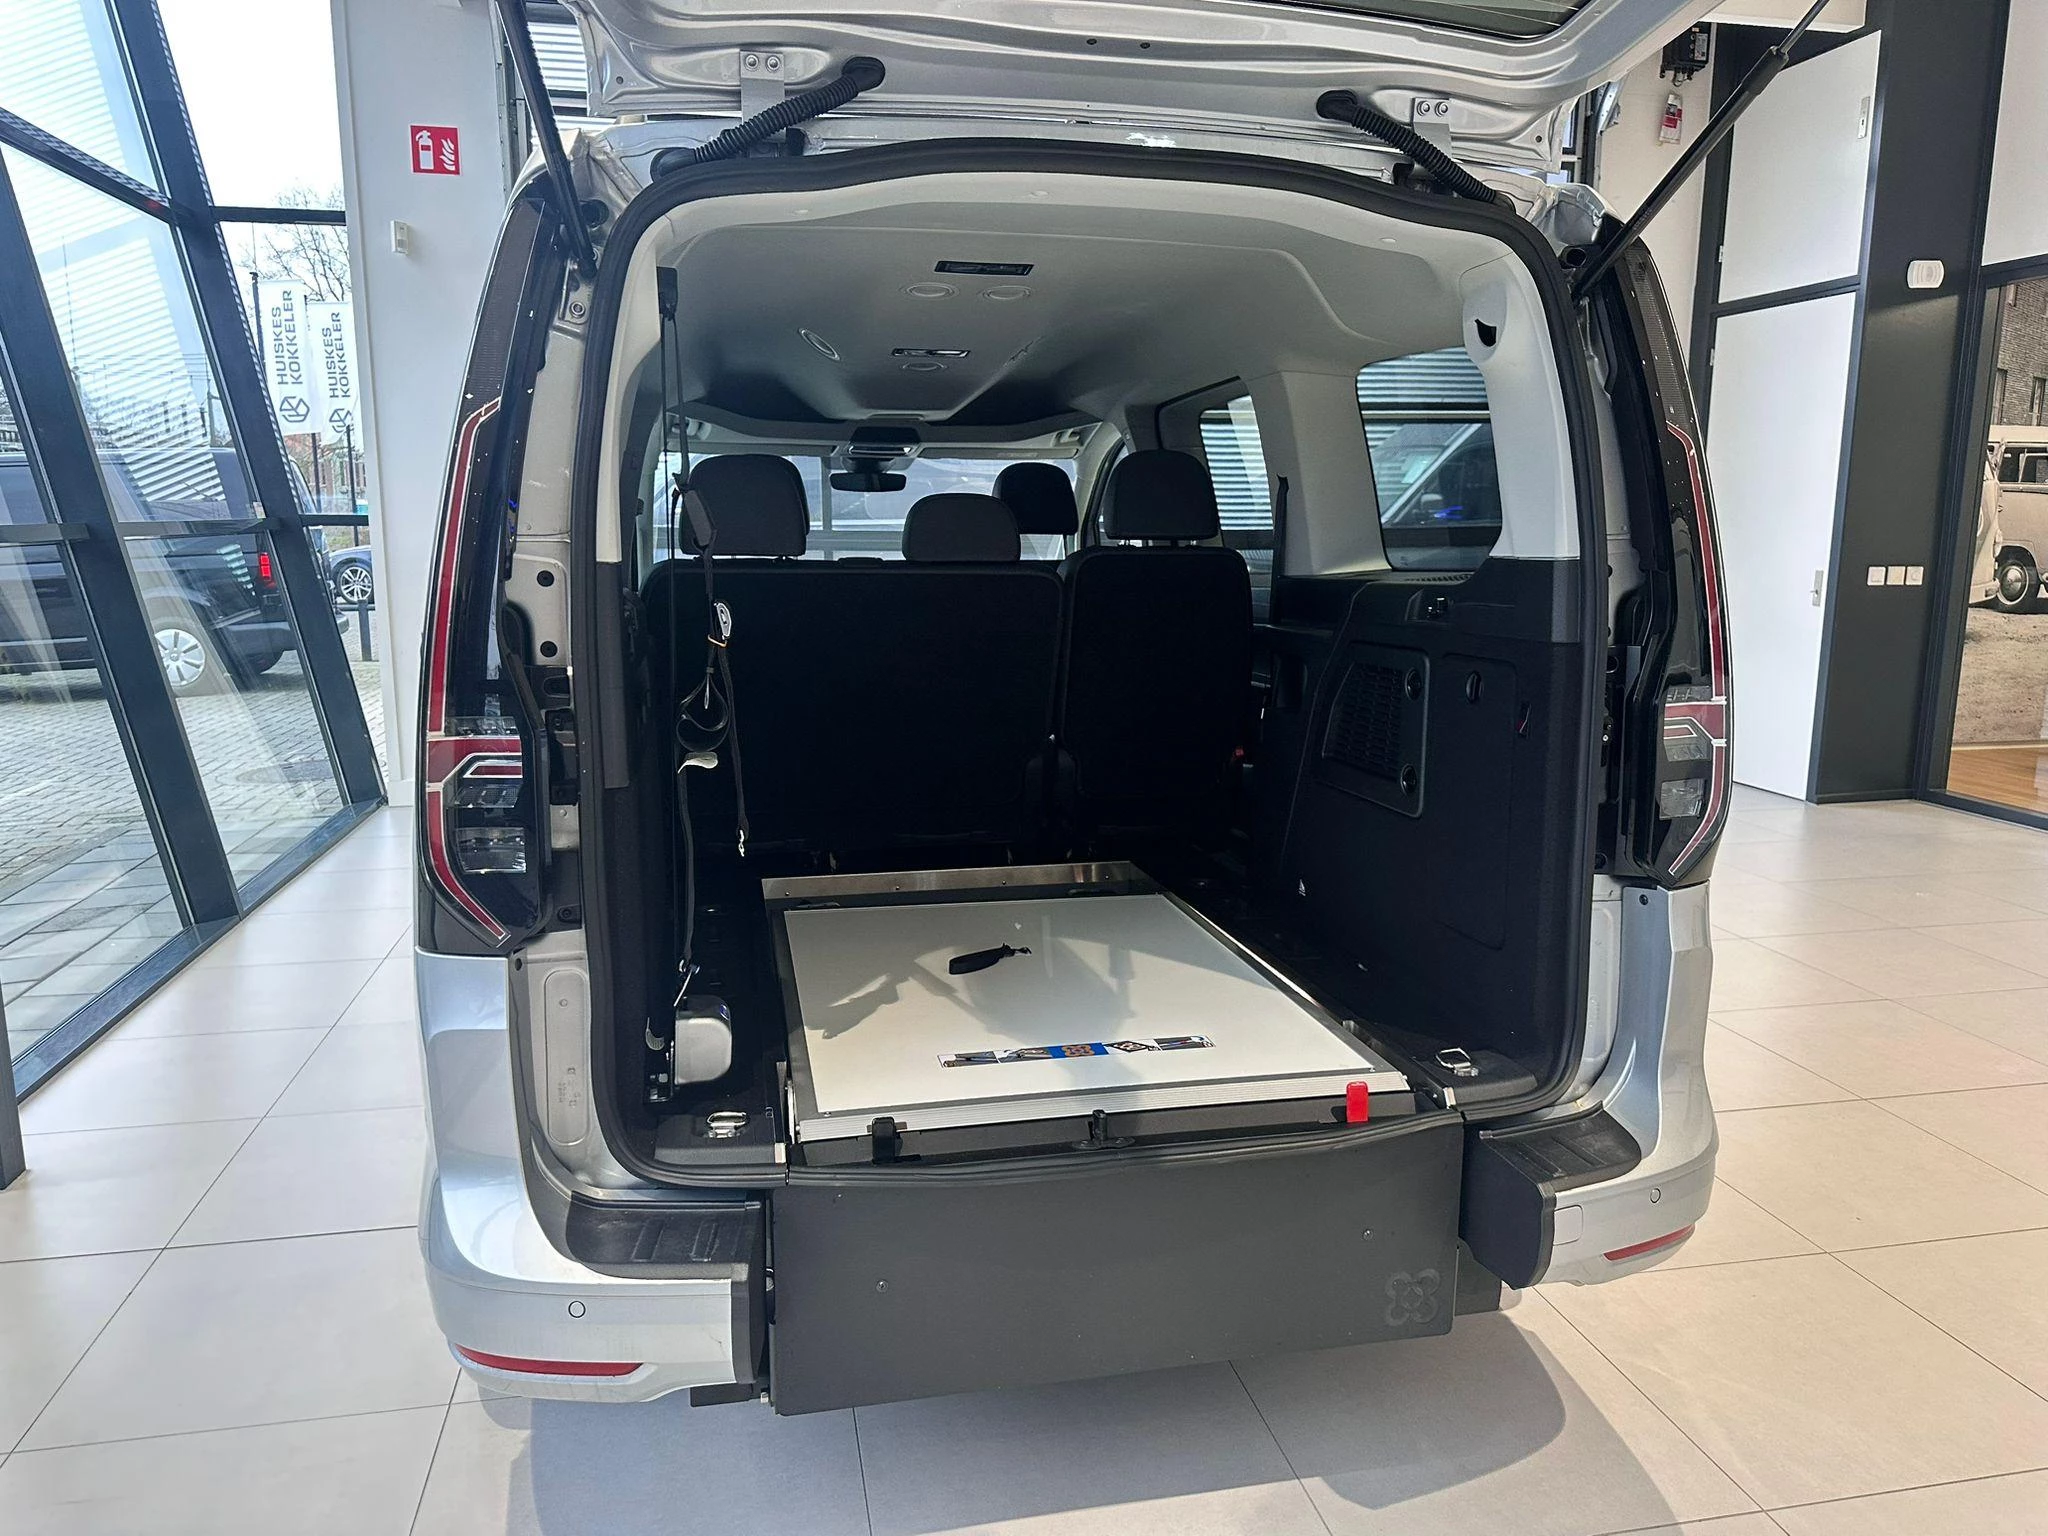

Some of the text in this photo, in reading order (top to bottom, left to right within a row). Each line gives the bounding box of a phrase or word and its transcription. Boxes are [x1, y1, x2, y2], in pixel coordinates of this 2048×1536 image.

[271, 306, 289, 385] HUISKES
[283, 289, 303, 385] KOKKELER
[321, 327, 340, 398] HUISKES
[331, 311, 351, 398] KOKKELER
